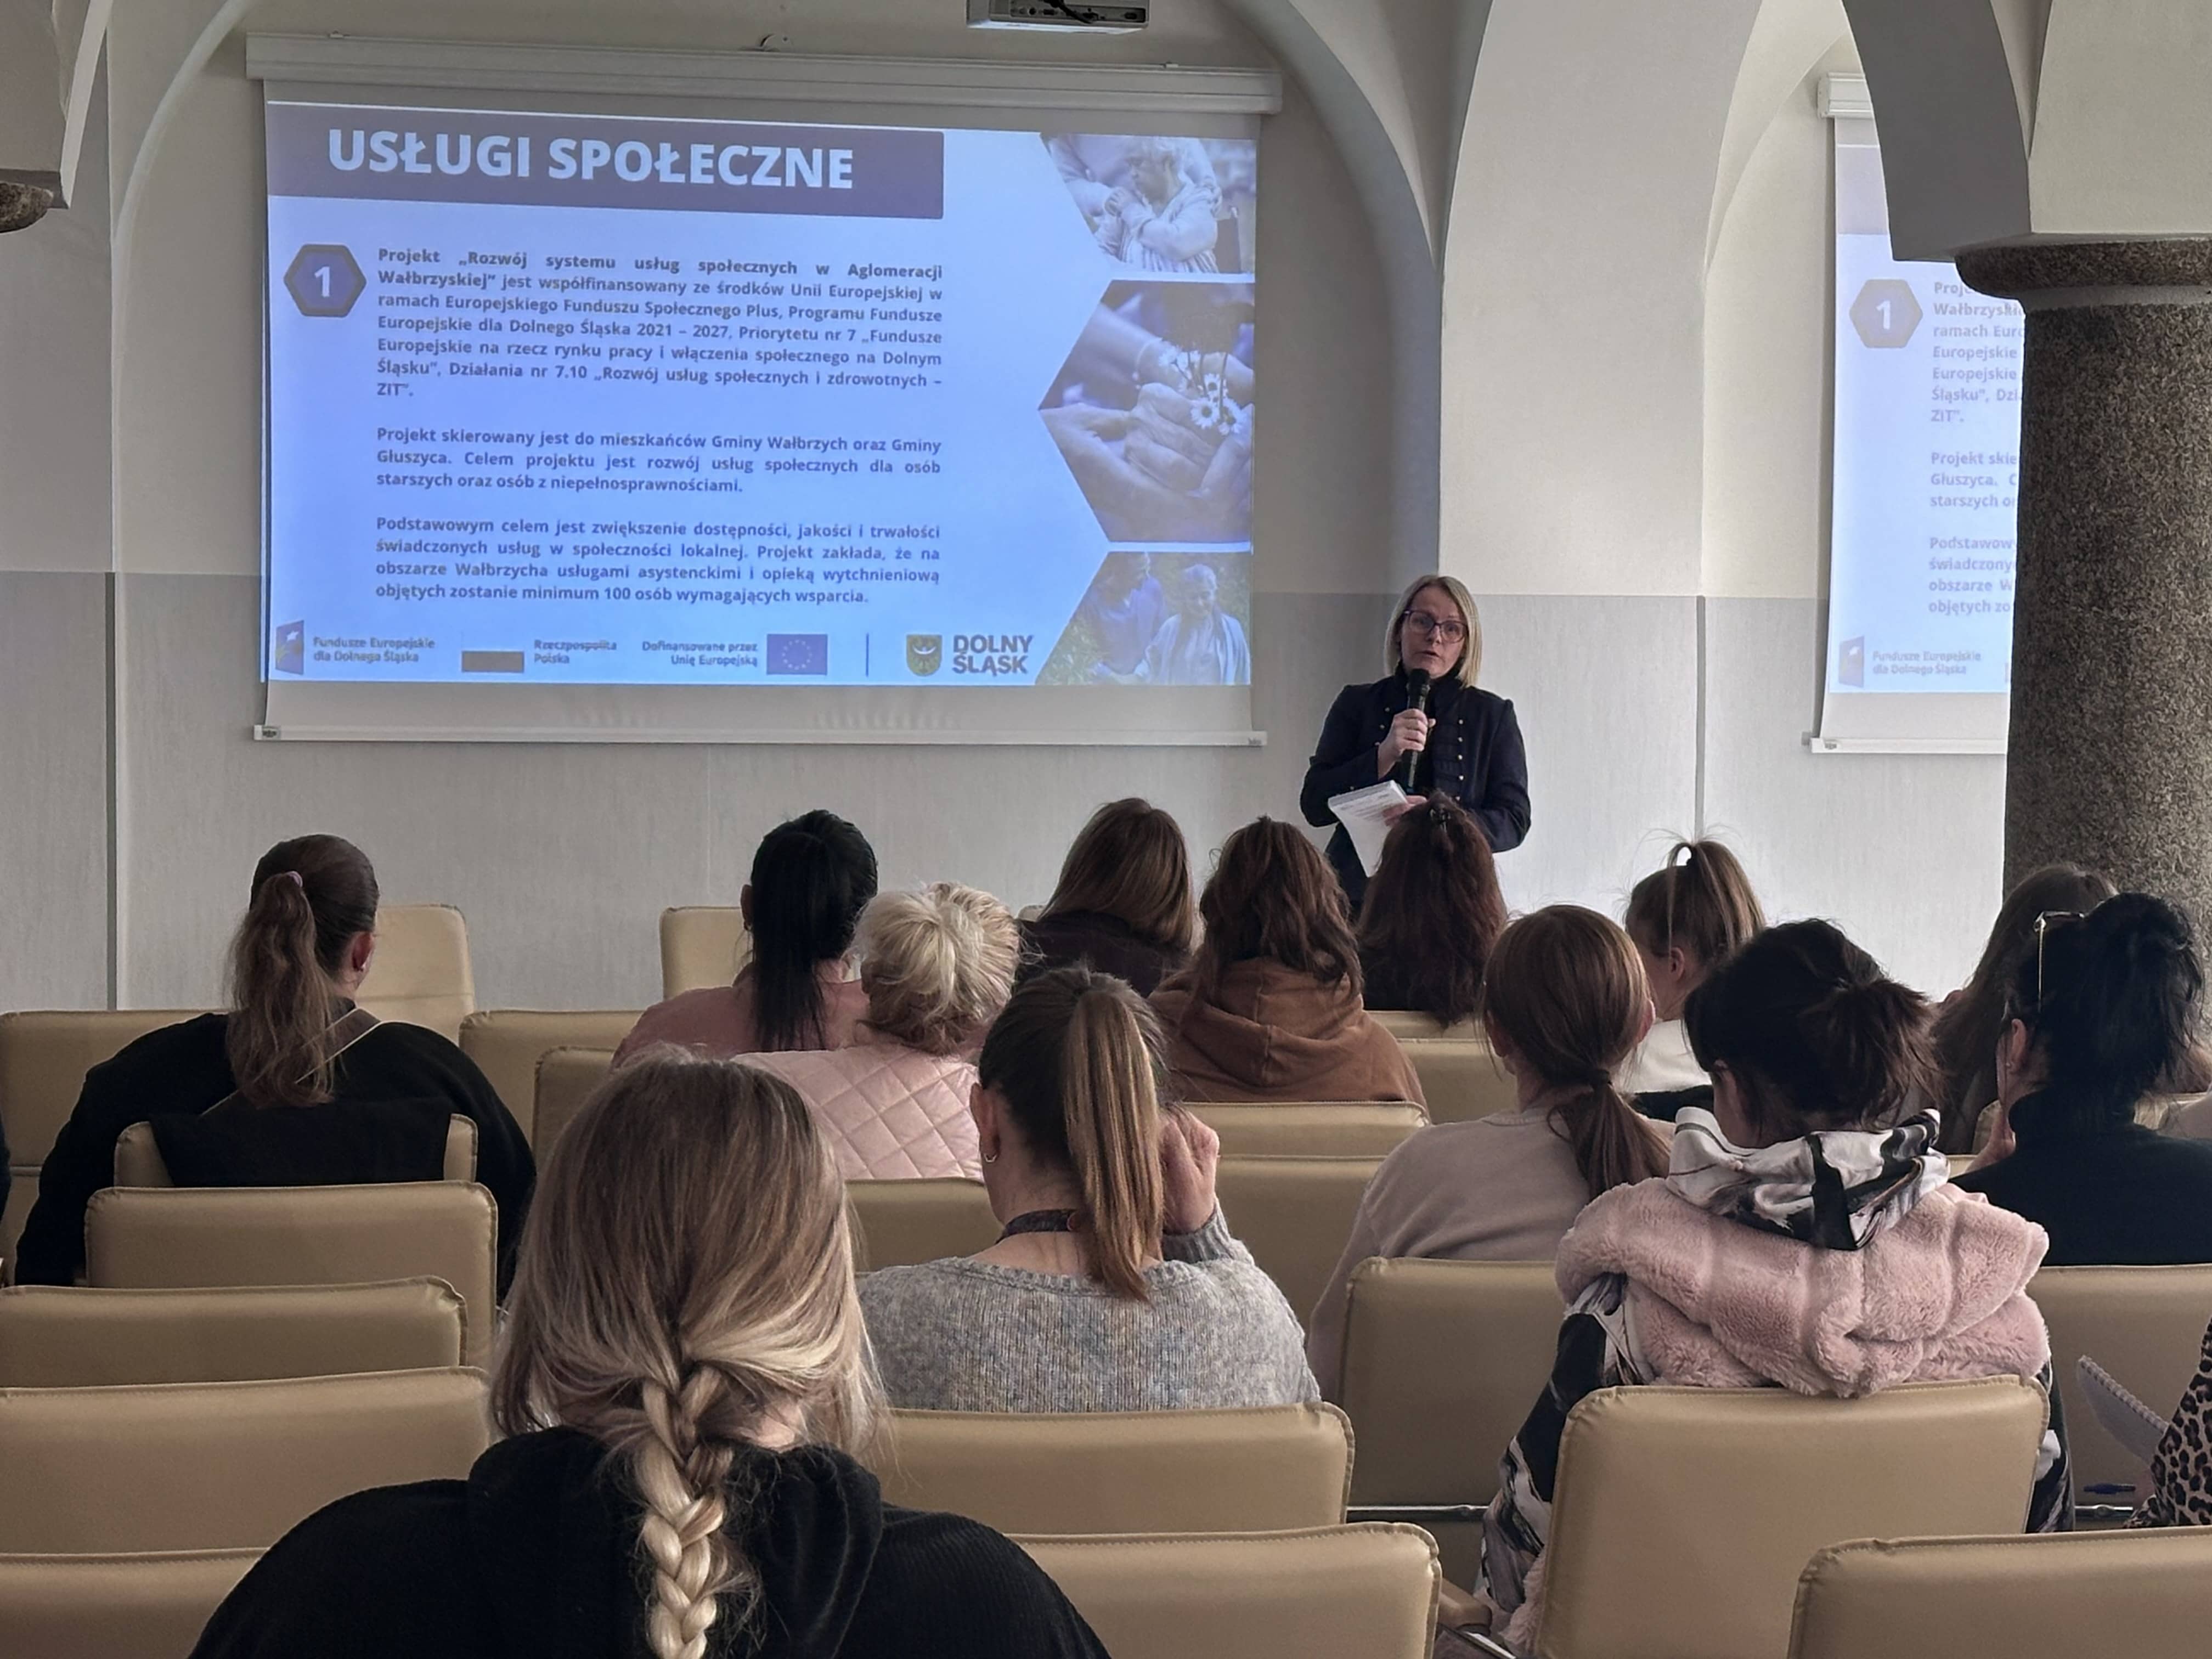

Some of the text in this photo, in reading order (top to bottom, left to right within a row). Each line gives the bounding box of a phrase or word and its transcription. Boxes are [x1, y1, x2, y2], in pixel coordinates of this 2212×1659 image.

[329, 129, 853, 189] USŁUGI SPOŁECZNE
[379, 248, 441, 266] Projekt
[546, 256, 616, 271] systemu
[634, 256, 680, 274] usług
[698, 258, 798, 278] społecznych
[816, 264, 830, 275] w
[847, 263, 943, 282] Aglomeracji
[314, 266, 330, 297] 1
[500, 274, 532, 291] jest
[538, 275, 687, 297] współfinansowany
[693, 283, 710, 294] ze
[716, 280, 785, 296] środków
[791, 283, 821, 297] Unii
[829, 284, 923, 303] Europejskiej
[929, 289, 943, 300] w
[378, 294, 943, 323] ramach Europejskiego Funduszu Społecznego Plus, Programu Fundusze
[1876, 301, 1891, 330] 1
[378, 315, 472, 334] Europejskie
[478, 317, 503, 332] dla
[509, 319, 574, 337] Dolnego
[580, 318, 631, 338] Śląska
[636, 323, 672, 337] 2021
[692, 324, 732, 340] 2027,
[739, 326, 819, 343] Priorytetu
[825, 330, 842, 341] nr
[847, 329, 856, 342] 7
[1933, 323, 1989, 338] ramach
[378, 338, 472, 357] Europejskie
[479, 343, 499, 354] na
[507, 344, 548, 356] rzecz
[555, 343, 601, 360] rynku
[608, 347, 653, 362] pracy
[671, 345, 748, 363] włączenia
[755, 348, 850, 367] społecznego
[856, 353, 876, 364] na
[883, 351, 942, 369] Dolnym
[1932, 345, 2018, 362] Europejskie
[449, 362, 523, 377] Działania
[531, 367, 549, 378] nr
[555, 365, 588, 379] 7.10
[666, 368, 709, 385] usług
[715, 369, 809, 387] społecznych
[827, 371, 927, 390] zdrowotnych
[1932, 366, 2017, 383] Europejskie
[377, 427, 942, 456] Projekt skierowany jest do mieszkańców Gminy Wałbrzych oraz Gminy
[377, 449, 941, 476] Głuszyca. Celem projektu jest rozwój usług społecznych dla osób
[1931, 450, 1984, 468] Projekt
[376, 472, 743, 494] starszych oraz osób z niepełnosprawnościami.
[1931, 472, 1999, 489] Głuszyca.
[1930, 494, 1999, 511] starszych
[377, 516, 494, 535] Podstawowym
[501, 518, 549, 533] celem
[554, 520, 586, 537] jest
[591, 521, 687, 538] zwiększenie
[693, 522, 792, 540] dostępności,
[797, 523, 852, 540] jakości
[870, 524, 940, 539] trwałości
[376, 538, 940, 562] świadczonych usług w społeczności lokalnej. Projekt zakłada, że na
[1929, 536, 2015, 551] Podstawow
[376, 560, 447, 575] obszarze
[455, 561, 548, 580] Wałbrzycha
[557, 563, 629, 582] usługami
[637, 565, 741, 583] asystenckimi
[762, 566, 815, 584] opieką
[822, 567, 940, 585] wytchnieniową
[1928, 557, 2015, 574] świadczony
[375, 583, 868, 606] objętych zostanie minimum 100 osób wymagających wsparcia.
[1928, 578, 1993, 592] obszarze
[1928, 599, 1991, 617] objętych
[313, 636, 435, 650] Fundusze Europejskie
[534, 639, 617, 653] Rzeczpospolita
[642, 640, 758, 653] Dofinansowane przez
[953, 634, 1034, 653] DOLNY
[313, 649, 419, 664] dla Dolnego Śląska
[534, 652, 570, 664] Polska
[670, 654, 758, 668] Unię Europejską
[952, 651, 1029, 676] ŚLĄSK
